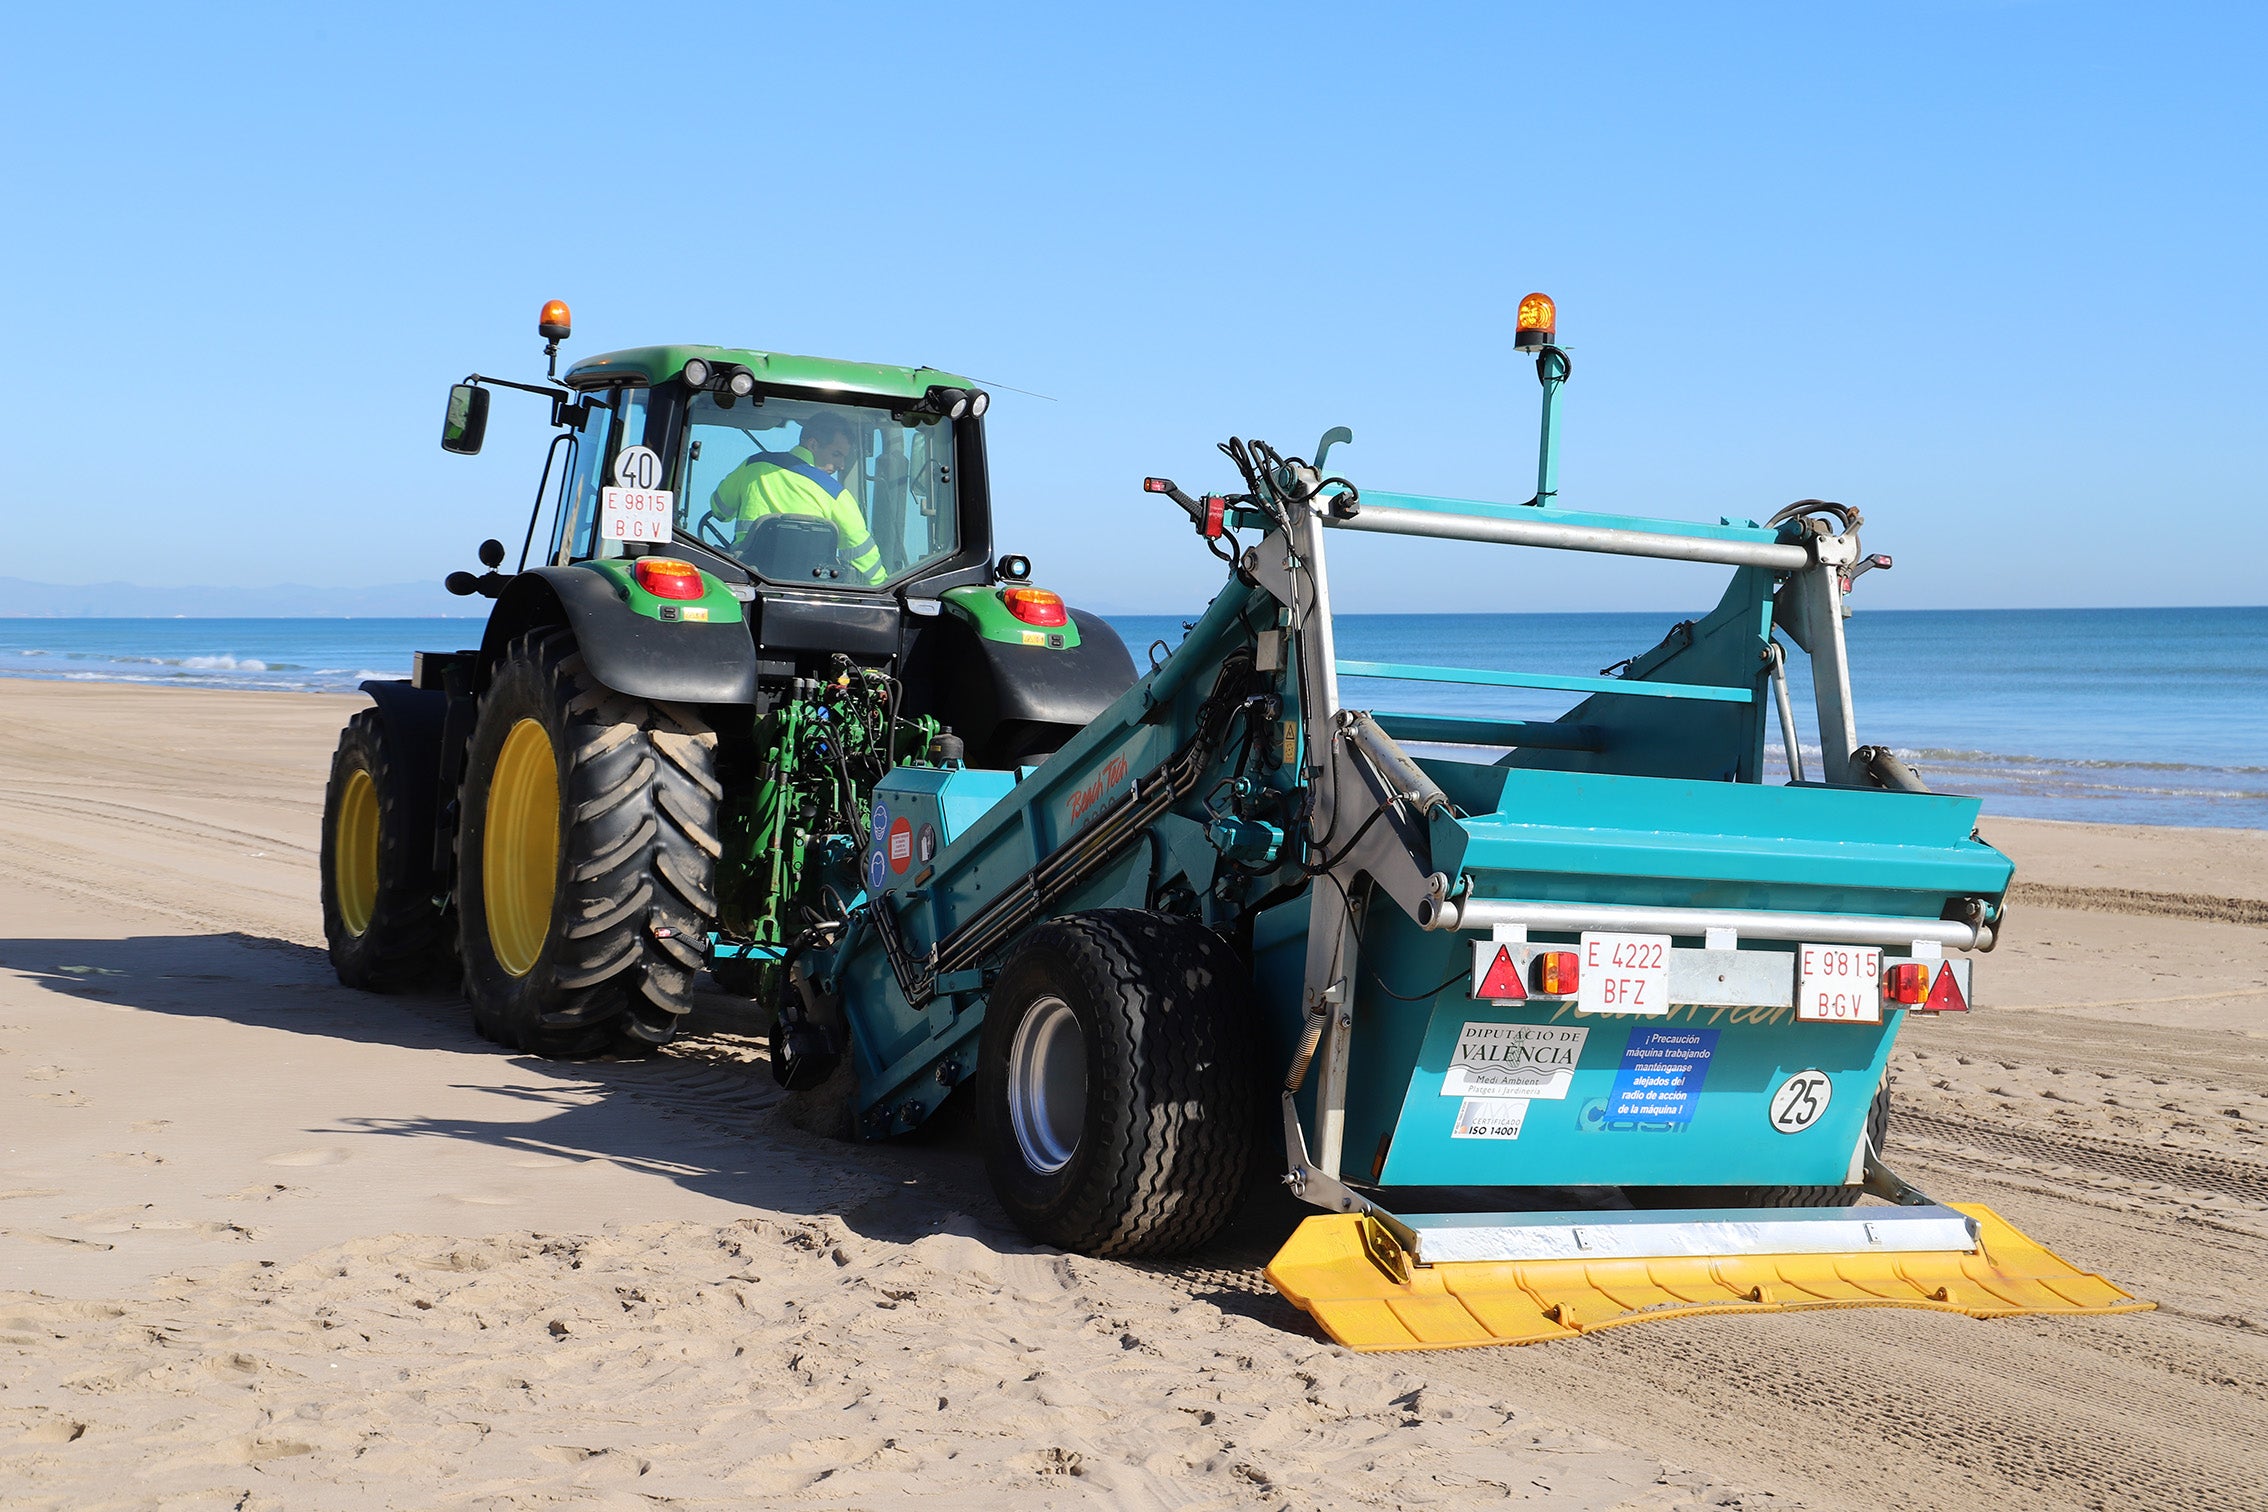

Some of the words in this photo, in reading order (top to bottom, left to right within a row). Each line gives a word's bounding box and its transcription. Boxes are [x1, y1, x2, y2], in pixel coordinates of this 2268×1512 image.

[622, 452, 653, 489] 40
[608, 493, 618, 509] E
[625, 494, 665, 512] 9815
[1588, 942, 1600, 967] E
[1612, 943, 1662, 969] 4222
[1804, 951, 1813, 976] E
[1823, 952, 1877, 978] 9815
[1604, 978, 1646, 1005] BFZ
[1465, 1028, 1554, 1041] DIPUTACIÓ
[1560, 1032, 1581, 1042] DE
[1651, 1033, 1700, 1044] Precaución
[1461, 1042, 1573, 1065] VALÈNCIA
[1626, 1048, 1663, 1059] máquina
[1665, 1049, 1711, 1060] trabajando
[1634, 1063, 1692, 1074] manténganse
[1476, 1075, 1498, 1085] Medi
[1500, 1076, 1539, 1086] Ambient
[1633, 1076, 1669, 1088] alejados
[1671, 1077, 1685, 1086] del
[1621, 1090, 1644, 1100] radio
[1646, 1090, 1657, 1100] de
[1658, 1091, 1687, 1101] acción
[1778, 1078, 1824, 1125] 25
[1617, 1104, 1629, 1114] de
[1630, 1104, 1639, 1114] la
[1640, 1104, 1676, 1116] máquina
[1472, 1117, 1521, 1126] CERTIFICADO
[1468, 1126, 1486, 1135] ISO
[1490, 1126, 1519, 1136] 14001
